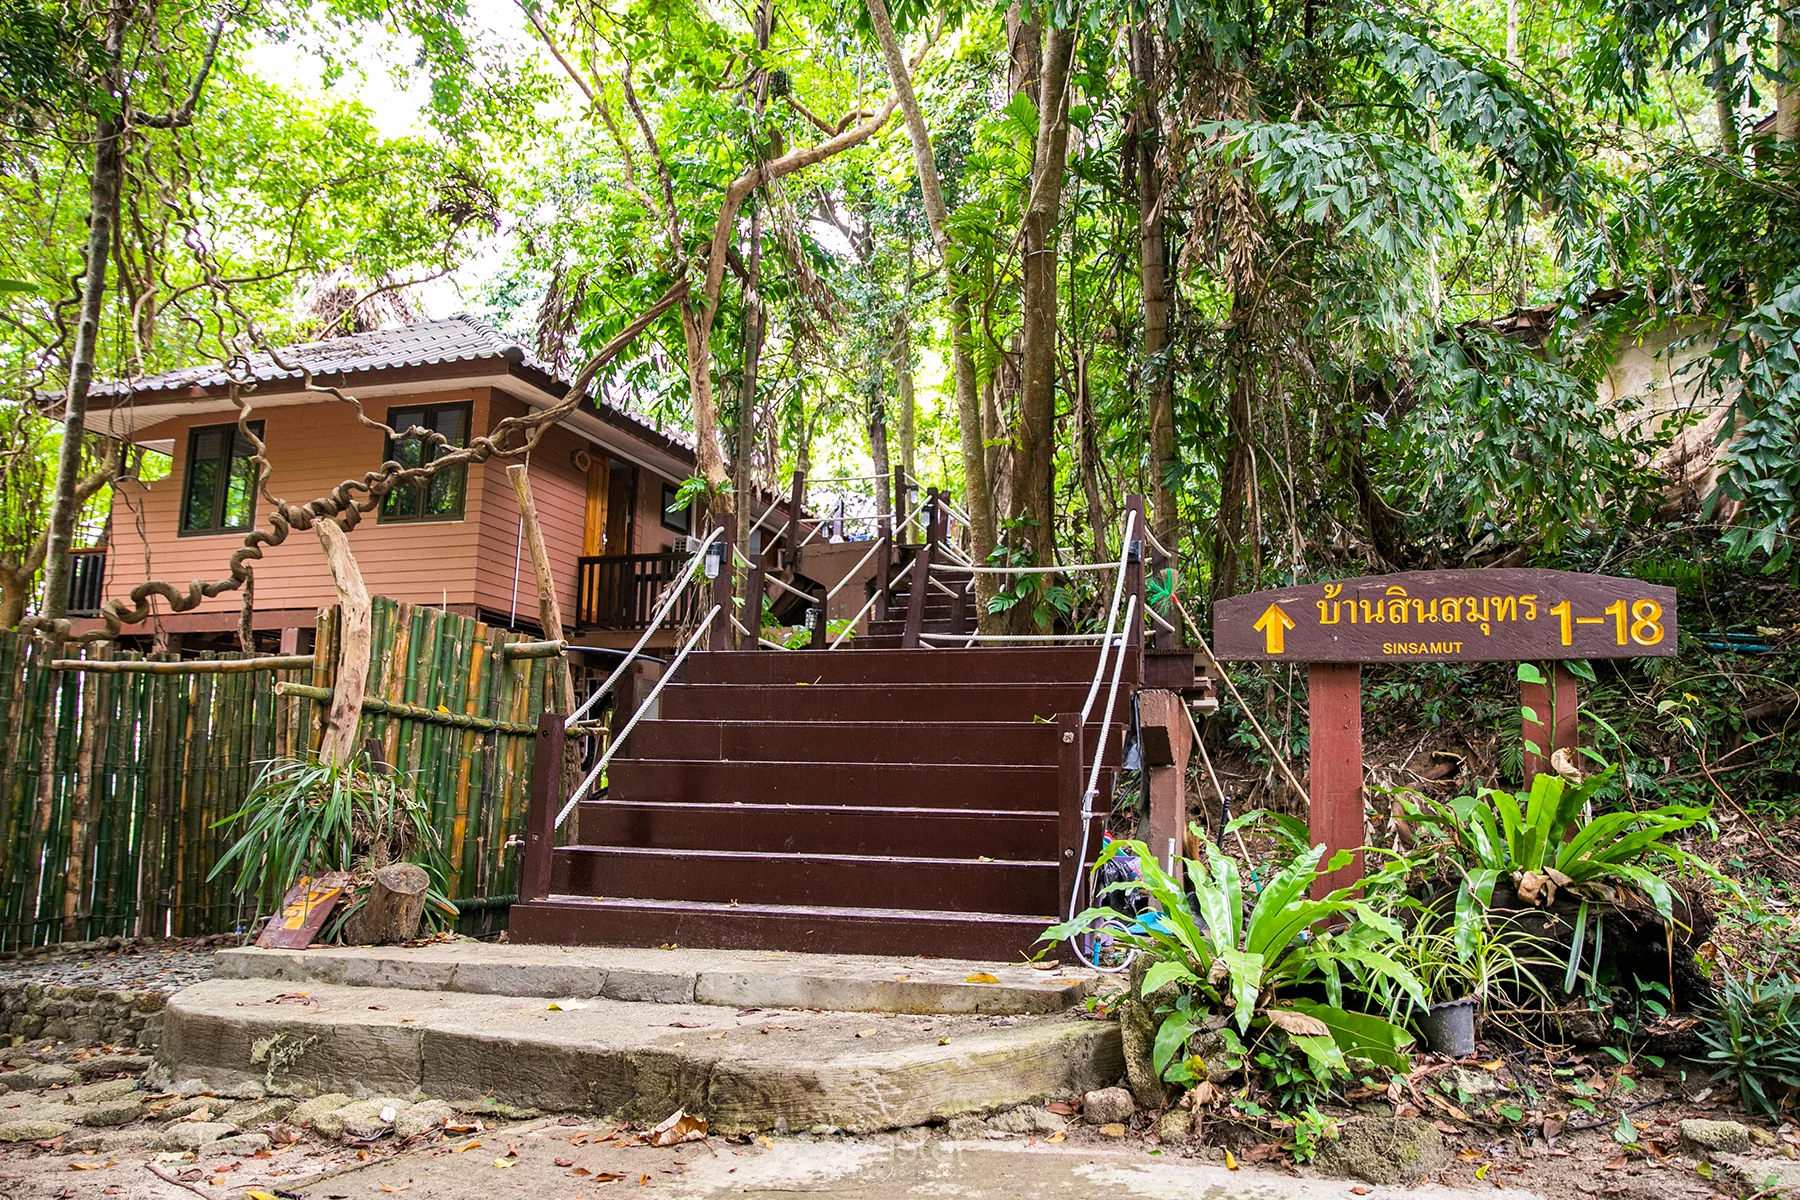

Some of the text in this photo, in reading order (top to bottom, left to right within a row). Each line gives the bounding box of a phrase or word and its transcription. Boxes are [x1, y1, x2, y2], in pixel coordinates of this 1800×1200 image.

[1316, 583, 1665, 647] บ้านสินสมุทร 1-18
[1382, 641, 1464, 655] SINSAMUT
